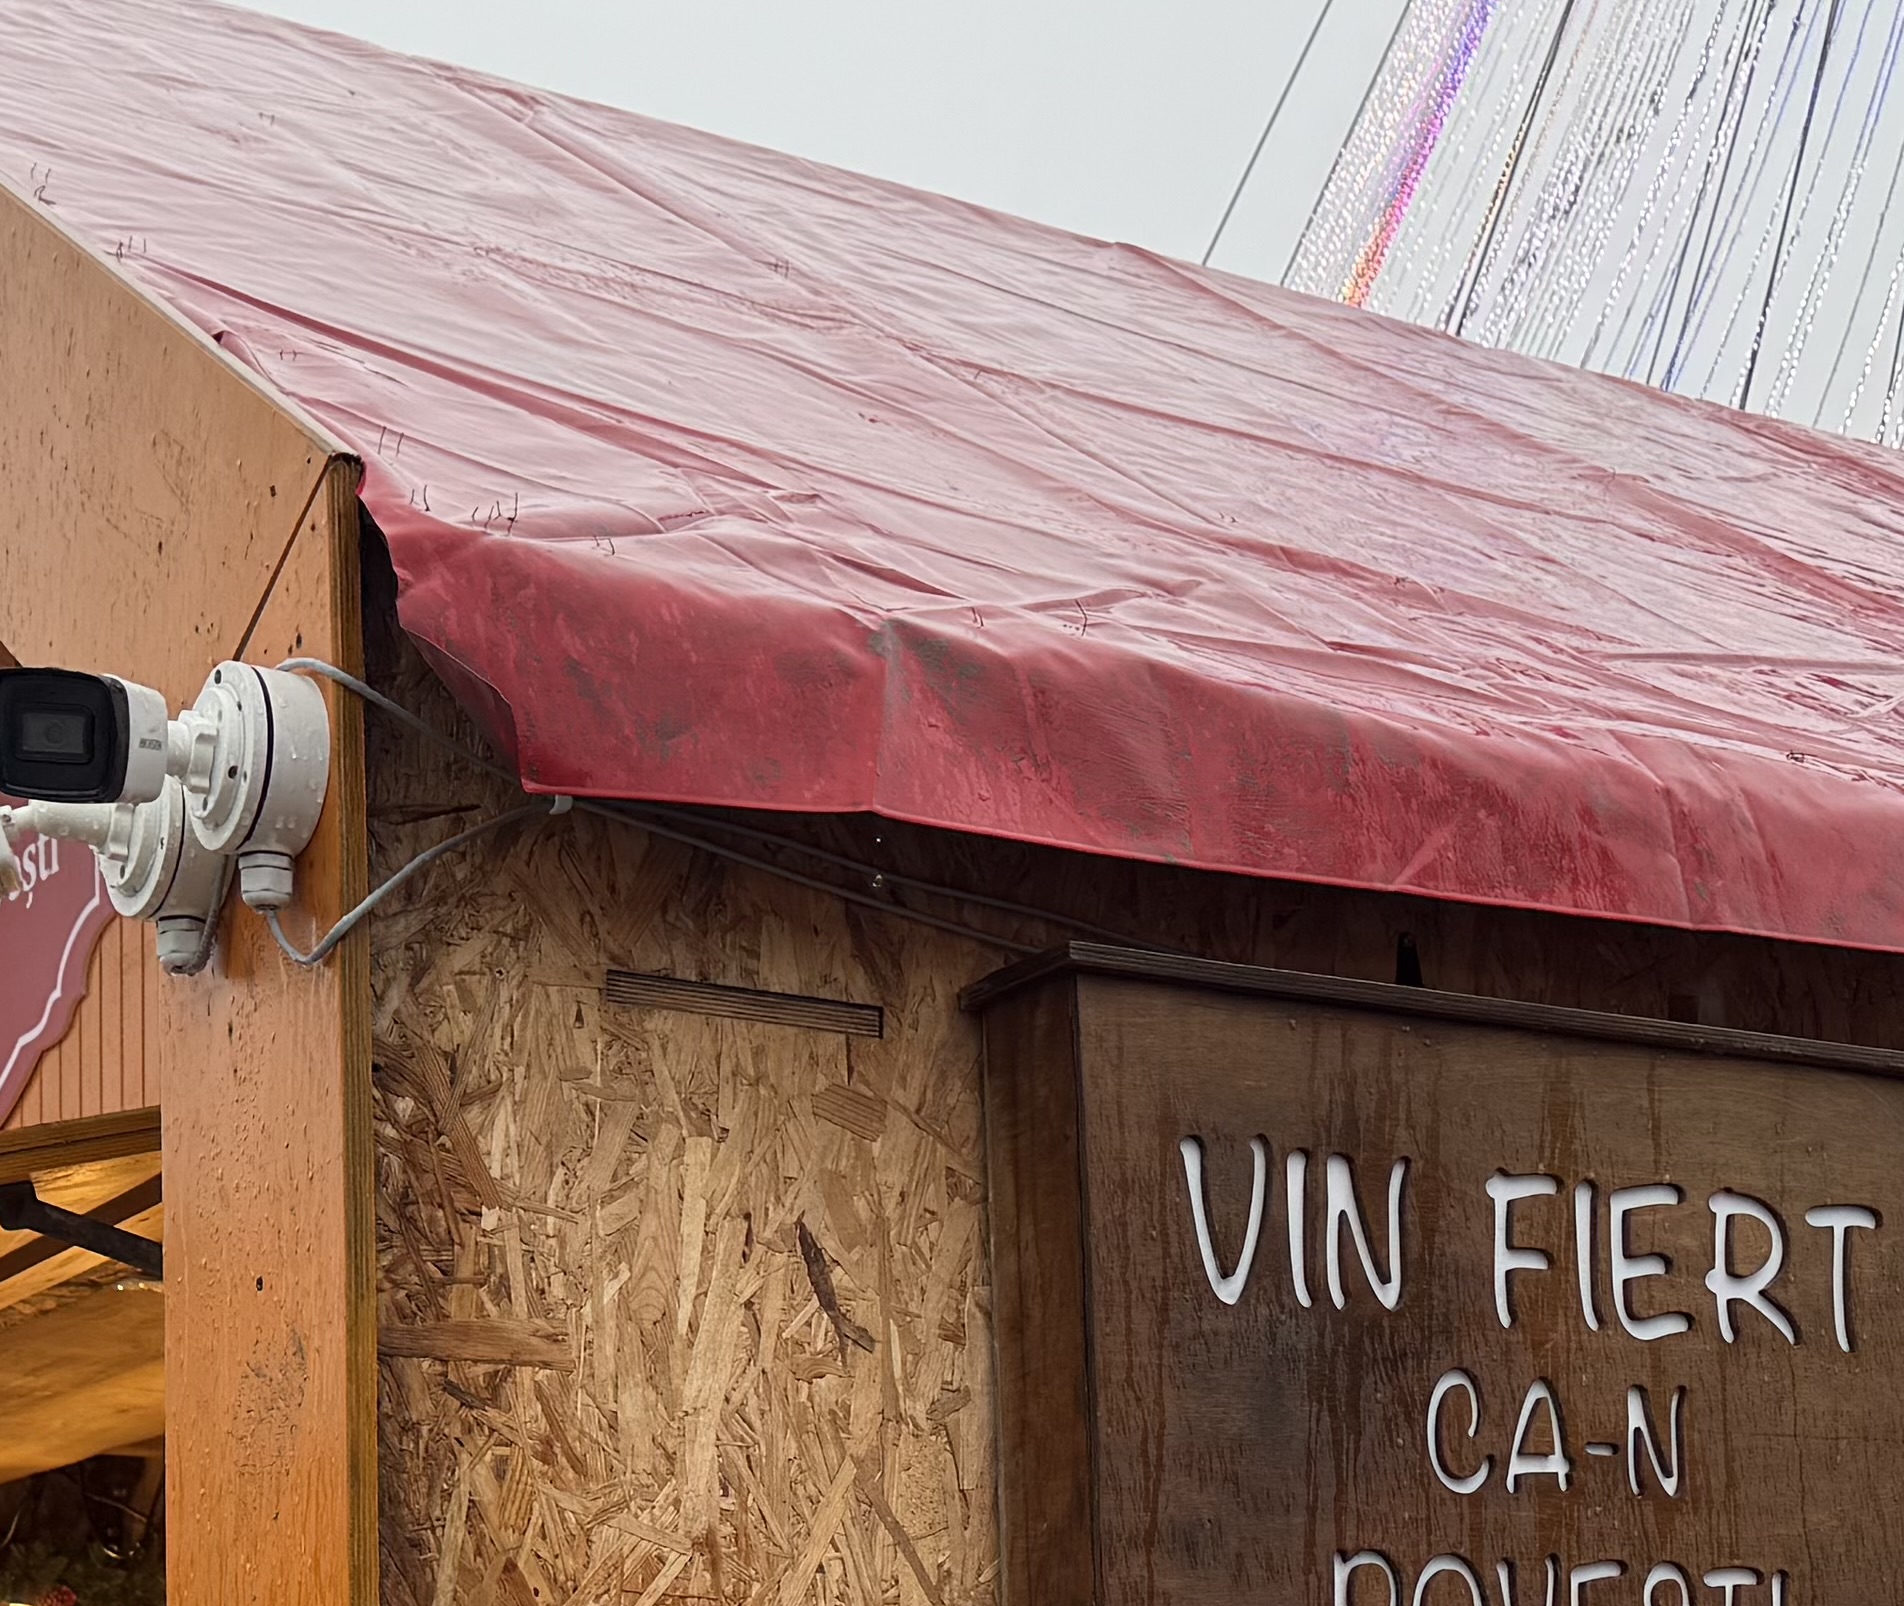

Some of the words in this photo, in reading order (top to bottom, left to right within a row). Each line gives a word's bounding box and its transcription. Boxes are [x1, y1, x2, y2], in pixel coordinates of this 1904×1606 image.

[1179, 1133, 1412, 1311] VIN
[1484, 1167, 1878, 1353] FIERT
[1426, 1368, 1686, 1499] CA-N
